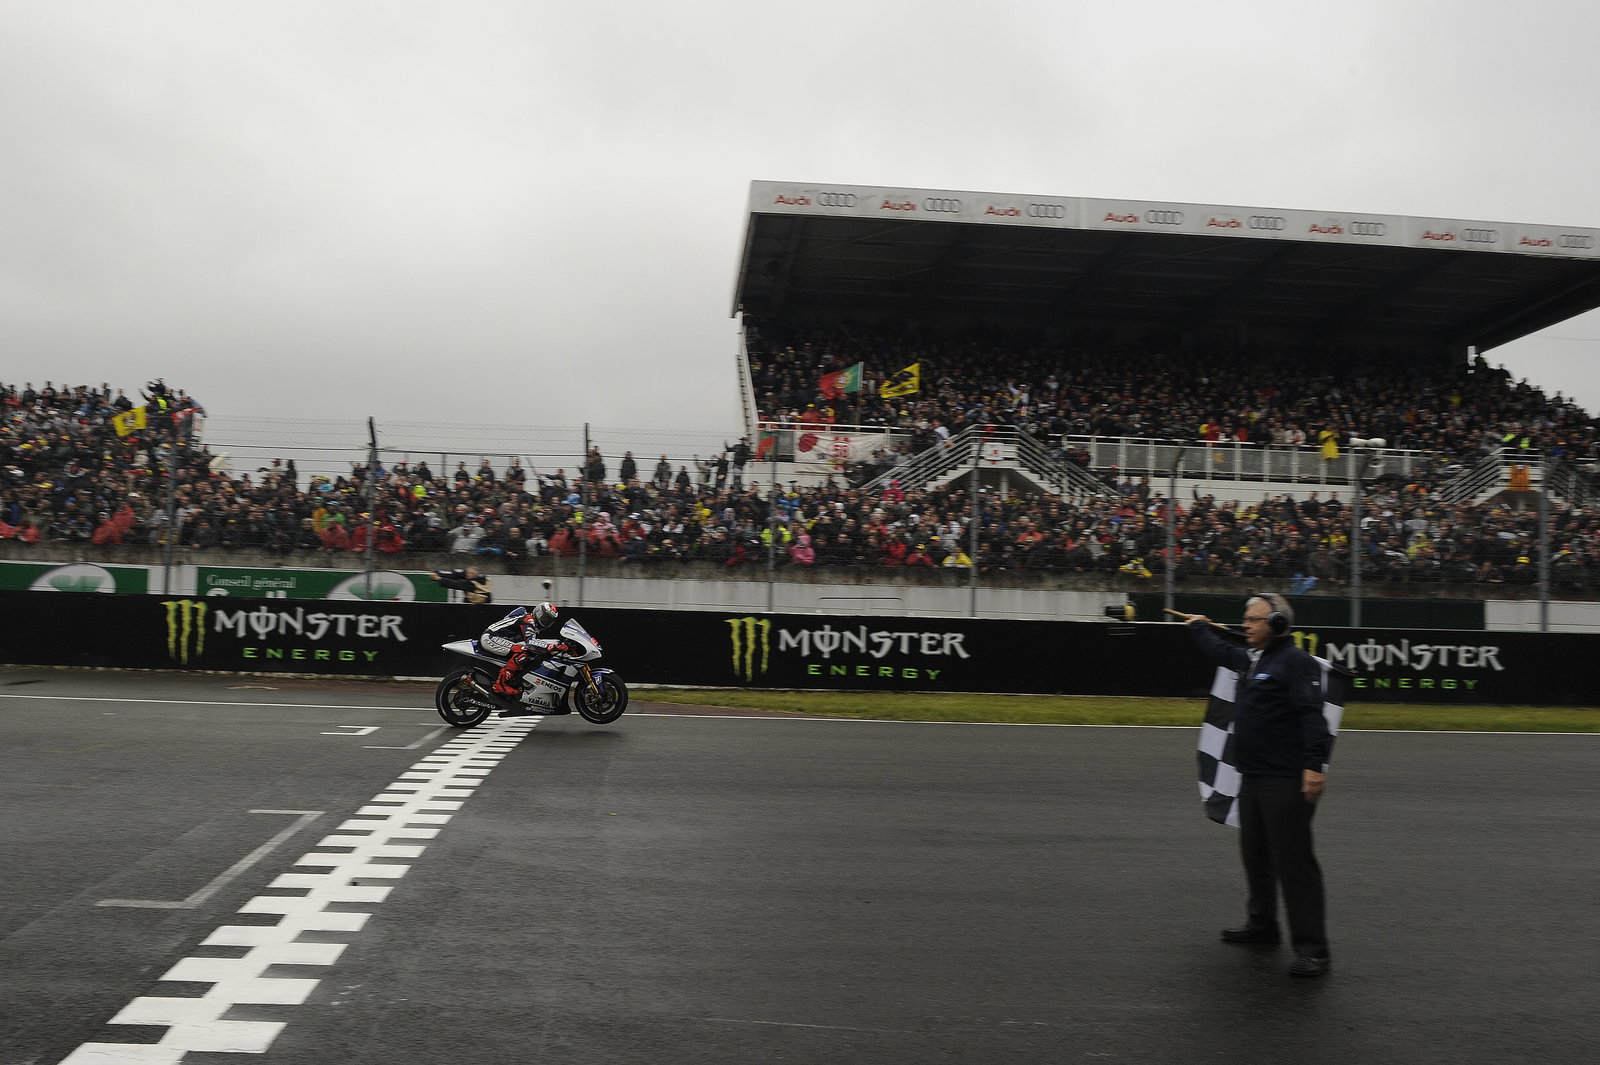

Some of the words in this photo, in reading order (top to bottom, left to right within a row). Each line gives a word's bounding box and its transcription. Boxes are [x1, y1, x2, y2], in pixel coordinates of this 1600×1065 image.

[774, 194, 811, 206] Audi
[880, 200, 917, 211] Audi
[985, 206, 1021, 217] Audi
[1104, 211, 1140, 223] Audi
[1206, 217, 1243, 229] Audi
[1309, 223, 1344, 235] Audi
[1422, 229, 1456, 241] Audi
[1520, 236, 1554, 248] Audi
[206, 574, 251, 587] Conseil
[252, 577, 297, 590] général
[214, 606, 408, 642] MONSTER
[777, 624, 971, 659] MONSTER
[242, 647, 381, 662] ENERGY
[1325, 637, 1505, 671] MONSTER
[806, 664, 942, 680] ENERGY
[541, 681, 563, 693] ENEOS
[1353, 677, 1480, 691] ENERGY
[528, 697, 551, 707] YAMAHA
